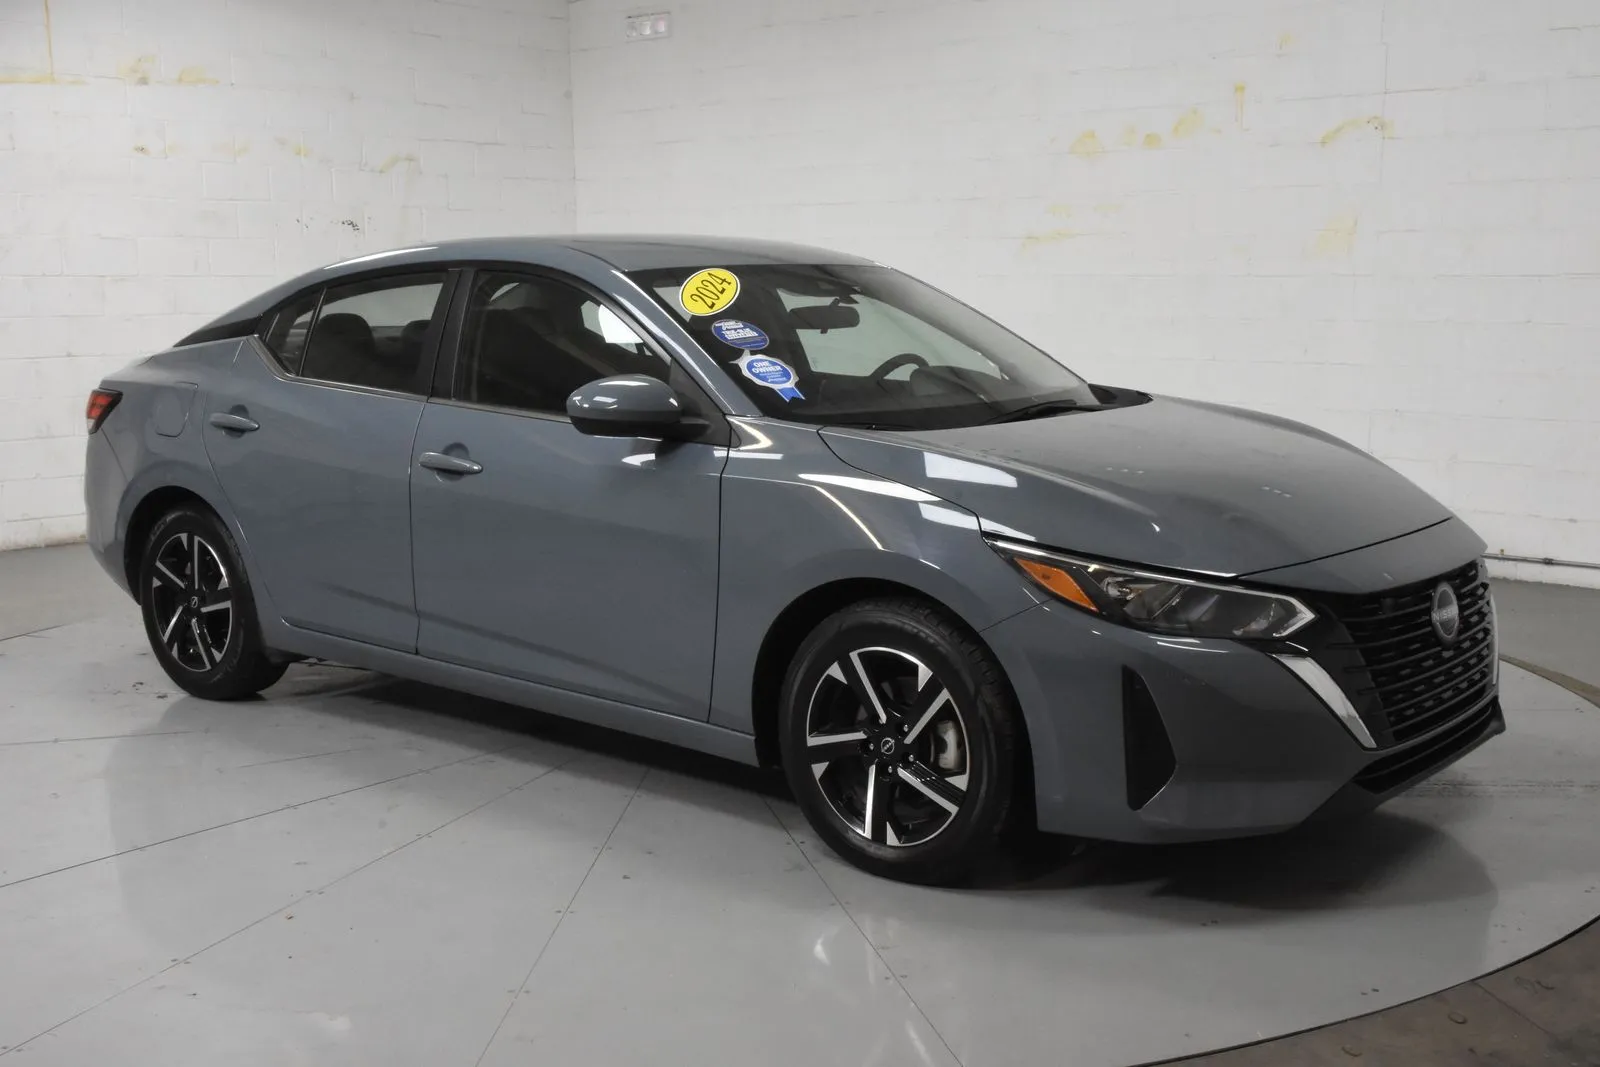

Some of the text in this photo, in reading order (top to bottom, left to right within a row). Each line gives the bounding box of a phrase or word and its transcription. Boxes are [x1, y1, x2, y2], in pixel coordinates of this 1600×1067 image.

[690, 272, 732, 310] 2024
[752, 365, 783, 374] OWNER
[753, 360, 771, 368] ONE
[1432, 607, 1457, 621] NISS
